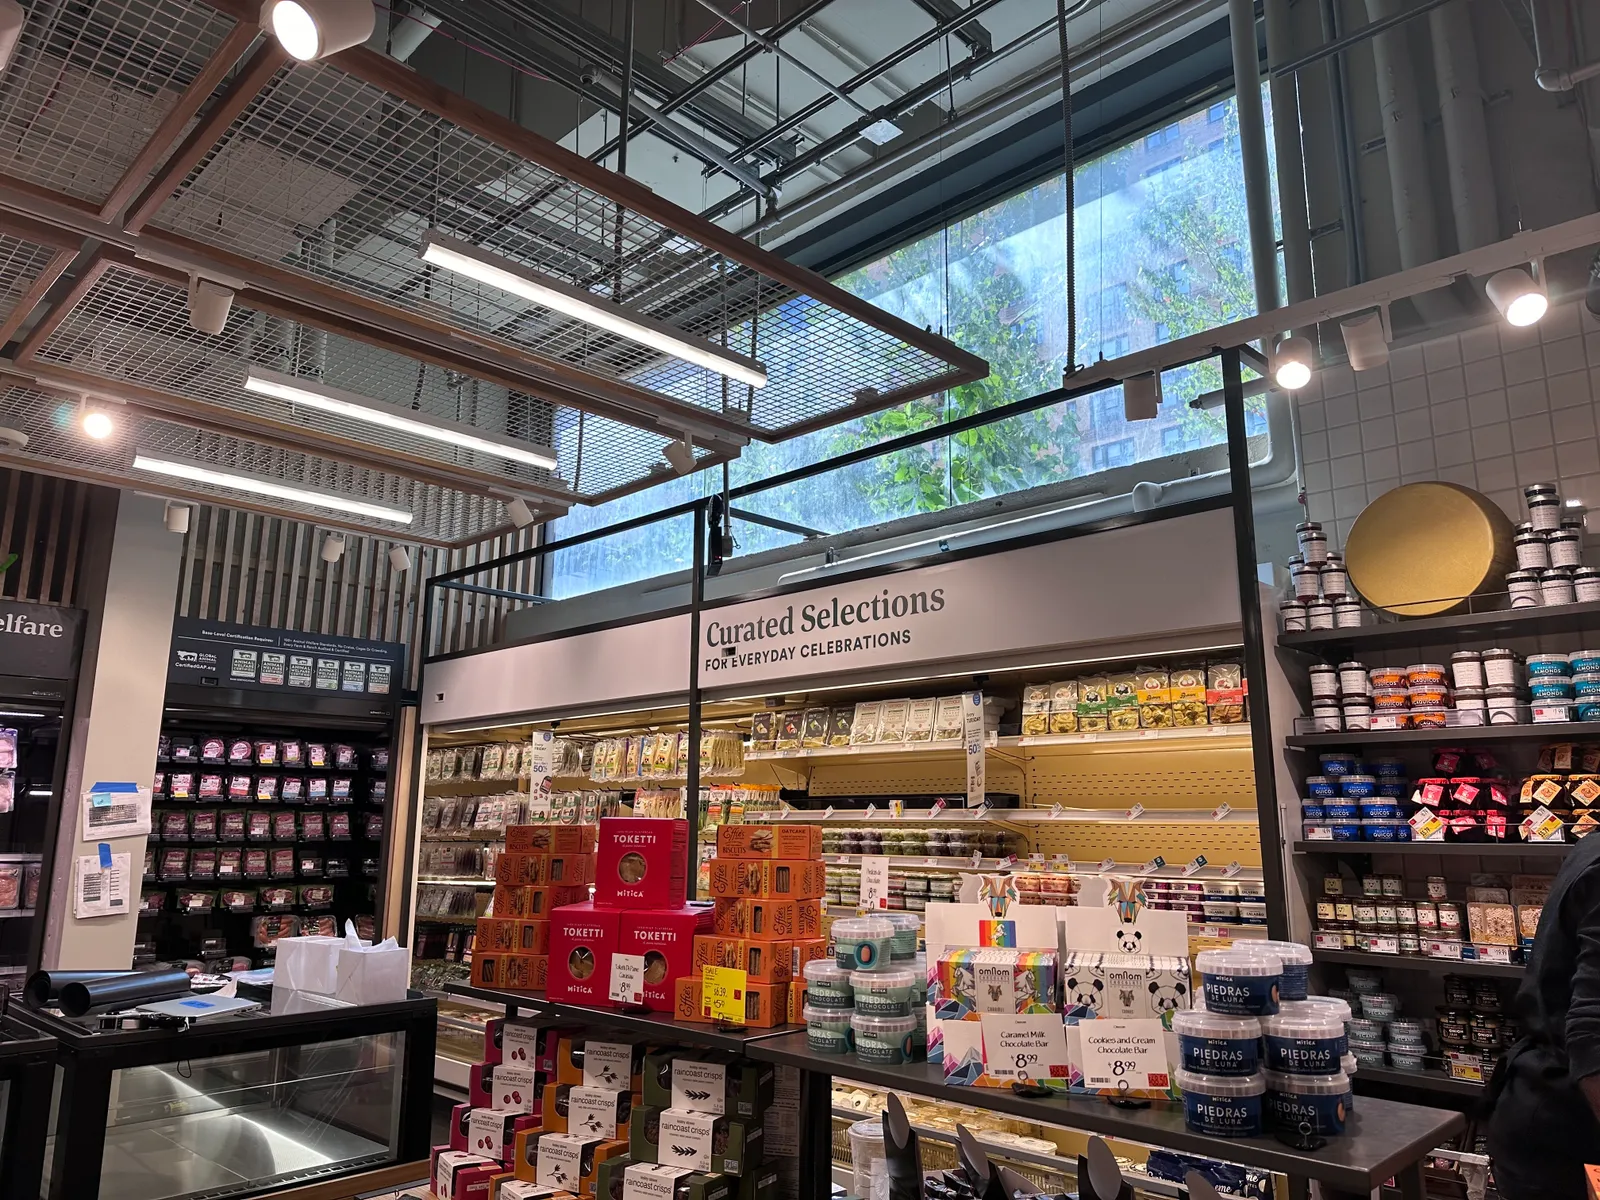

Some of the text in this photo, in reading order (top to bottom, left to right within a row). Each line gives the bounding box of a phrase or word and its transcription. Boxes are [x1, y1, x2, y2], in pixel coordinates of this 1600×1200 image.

[707, 588, 945, 648] Curated Selections
[705, 629, 911, 671] FOR EVERYDAY CELEBRATIONS
[613, 835, 656, 844] TOKETTI
[723, 826, 745, 841] Effie's
[500, 858, 511, 882] Effie's
[713, 864, 728, 893] Effie's
[737, 862, 745, 894] BISCUITS
[773, 907, 784, 935] Effie's
[806, 905, 818, 933] Effie's
[479, 924, 489, 948] Effie's
[563, 928, 604, 938] TOKETTI
[634, 930, 677, 941] TOKETTI
[696, 942, 706, 972] Effie's
[774, 949, 783, 977] Effie's
[705, 967, 718, 975] SALE
[979, 966, 1010, 975] omnom
[1109, 971, 1142, 980] omnom
[1206, 983, 1250, 997] PIEDRAS
[679, 986, 695, 1017] Effie's
[861, 995, 897, 1004] PIEDRAS
[586, 1049, 612, 1057] raincoast
[1193, 1048, 1243, 1060] PIEDRAS
[1280, 1048, 1330, 1060] PIEDRAS
[674, 1069, 723, 1081] raincoast crisps
[570, 1096, 615, 1108] raincoast crisps
[1269, 1099, 1316, 1116] PIEDRAS
[1197, 1104, 1247, 1118] PIEDRAS
[471, 1118, 502, 1130] raincoast crisps
[661, 1122, 711, 1136] raincoast crisps
[540, 1146, 579, 1159] raincoast crisps
[626, 1178, 672, 1194] raincoast crisps
